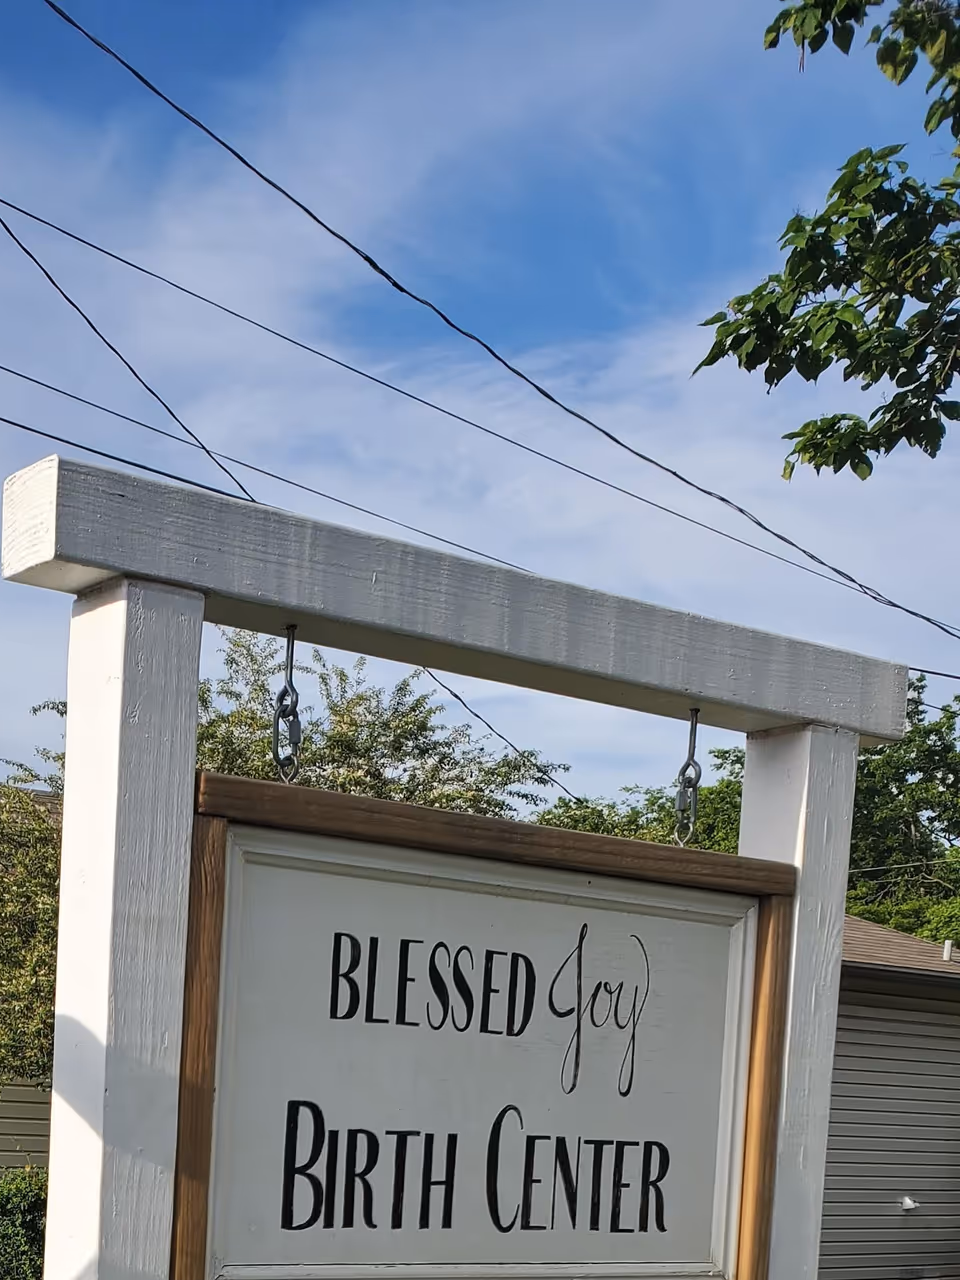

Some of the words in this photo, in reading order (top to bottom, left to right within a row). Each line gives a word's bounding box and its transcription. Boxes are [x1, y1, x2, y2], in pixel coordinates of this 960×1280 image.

[329, 931, 537, 1038] BLESSED
[548, 922, 650, 1098] Joy
[280, 1099, 459, 1231] BIRTH
[486, 1104, 671, 1234] CENTER
